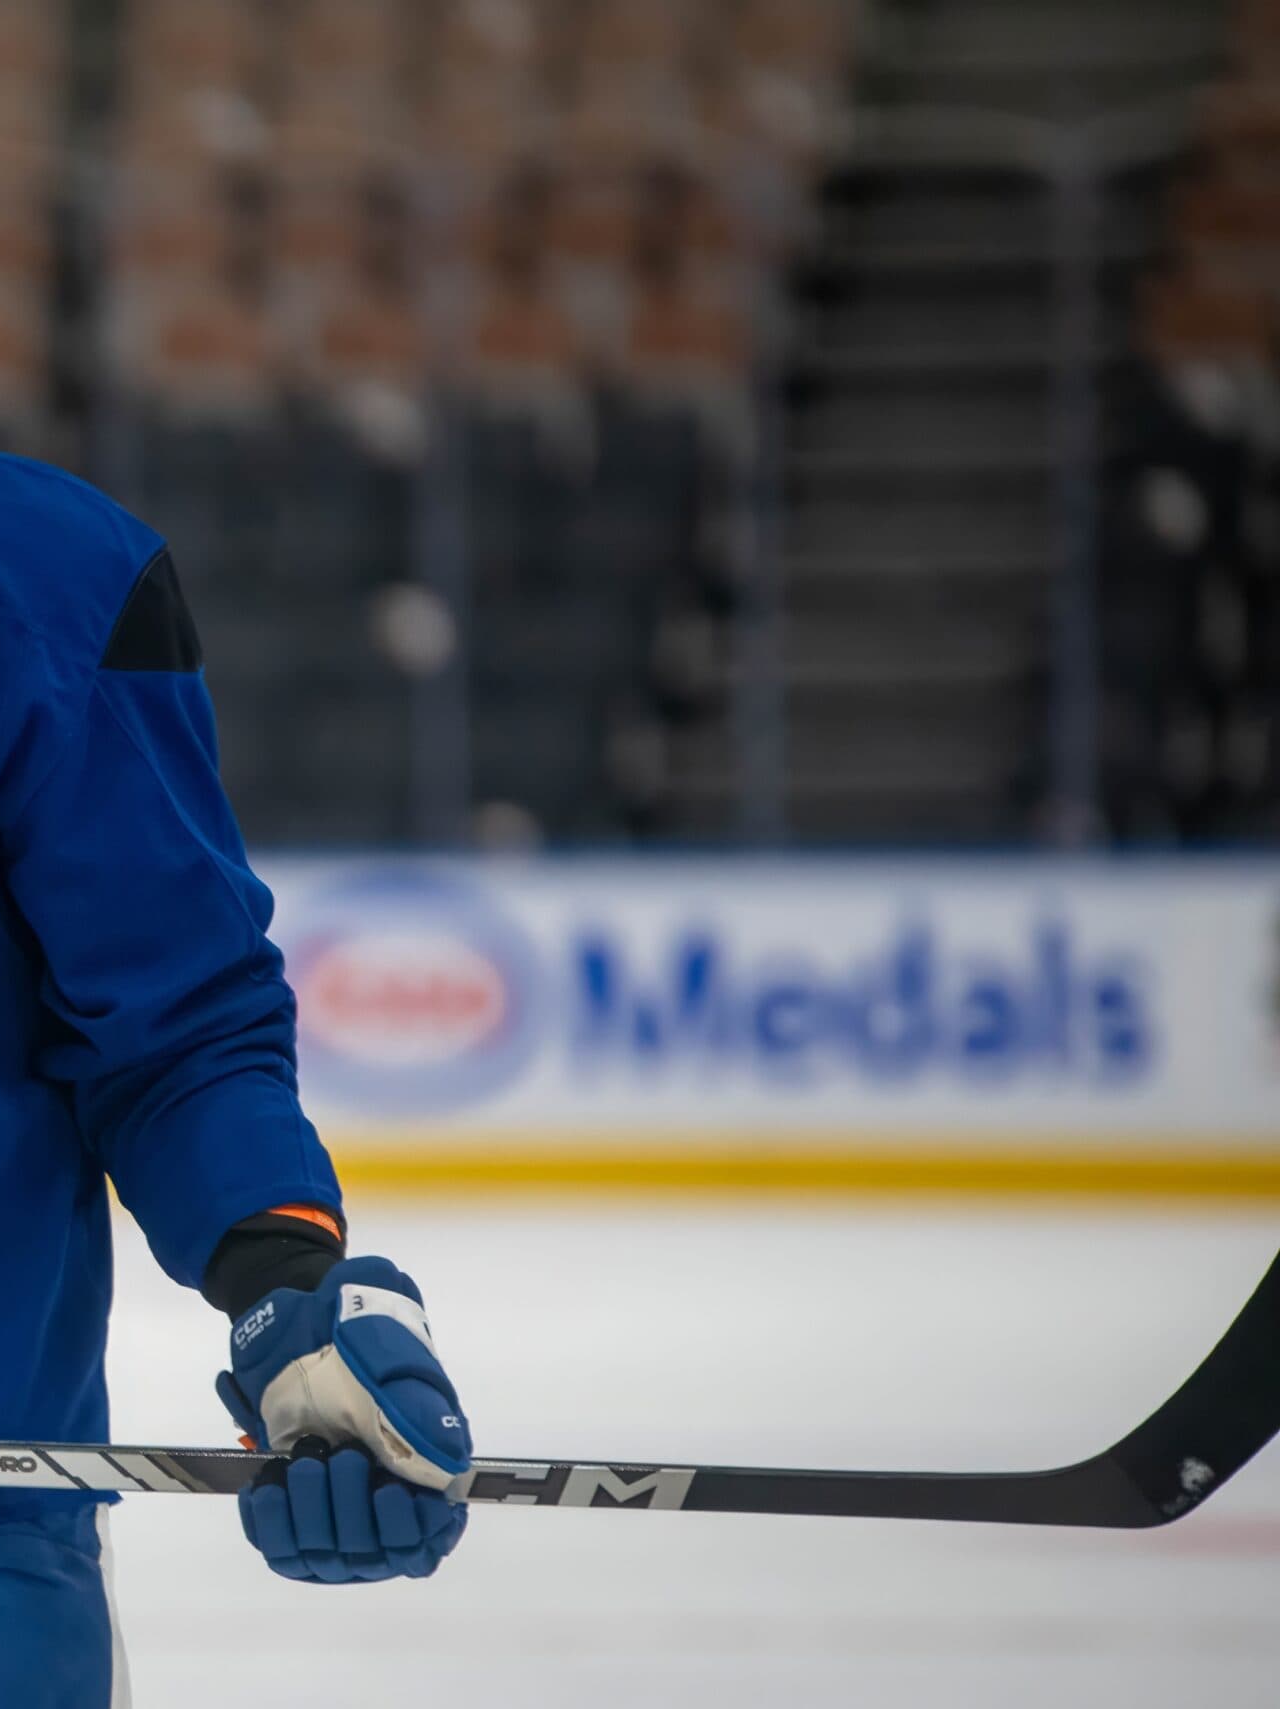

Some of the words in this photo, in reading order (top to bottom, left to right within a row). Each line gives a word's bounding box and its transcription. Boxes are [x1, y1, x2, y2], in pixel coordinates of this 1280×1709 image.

[568, 910, 1162, 1086] Medals
[234, 1301, 274, 1346] CCM
[447, 1463, 697, 1510] CM
